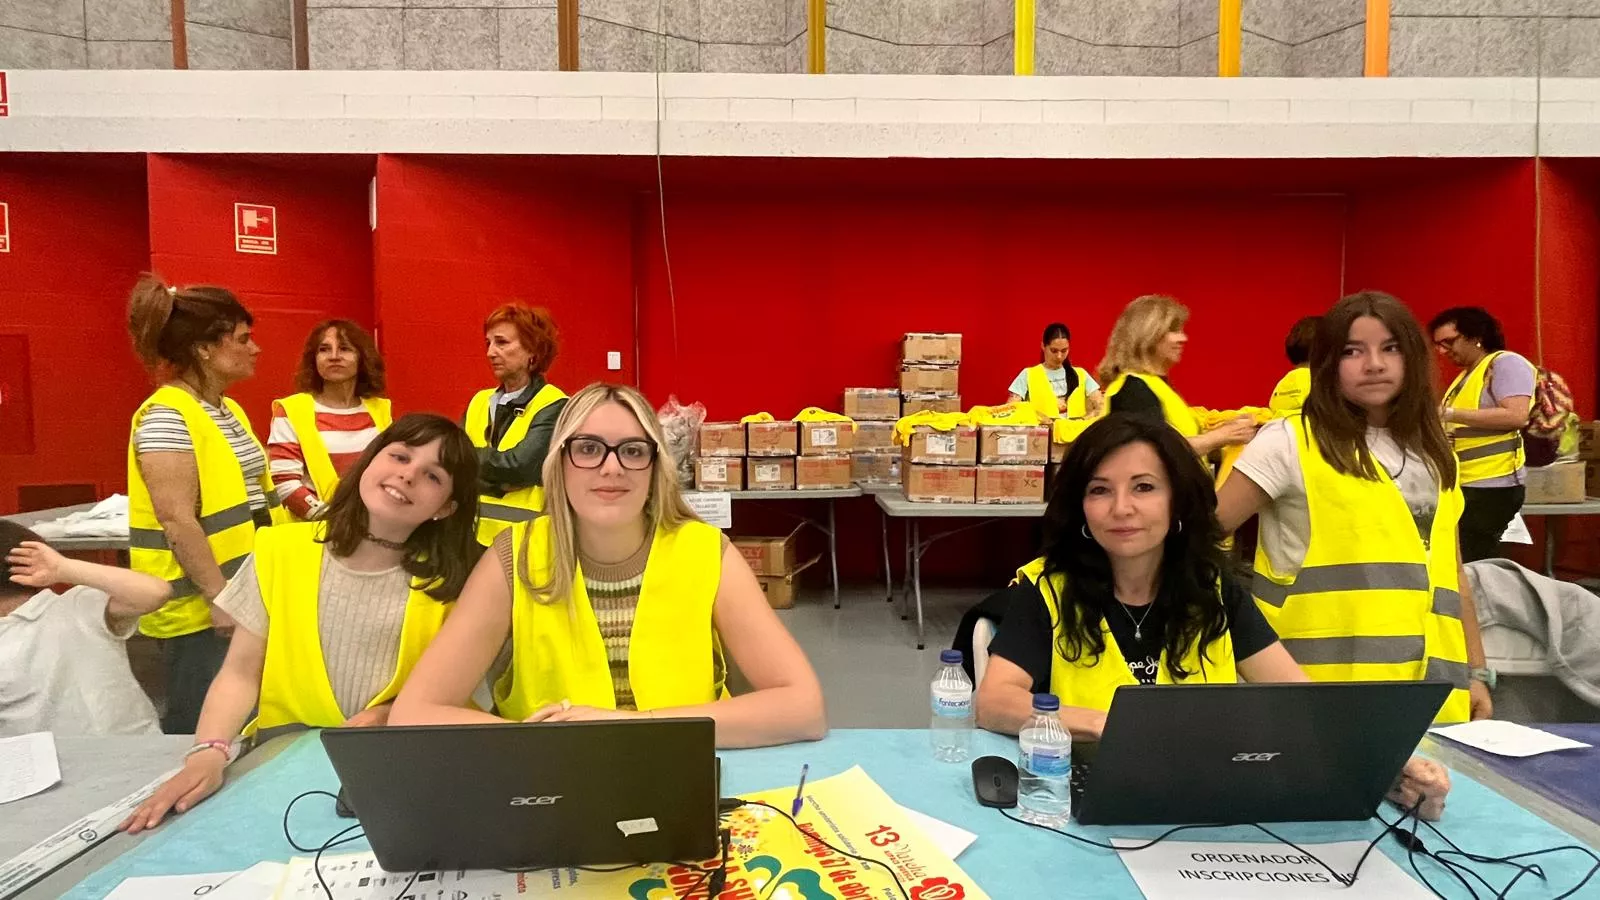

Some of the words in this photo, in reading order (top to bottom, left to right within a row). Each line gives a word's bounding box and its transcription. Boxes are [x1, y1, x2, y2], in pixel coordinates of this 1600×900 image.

[1231, 752, 1281, 761] acer
[509, 795, 564, 806] acer
[865, 824, 900, 847] 13
[819, 856, 851, 869] 27
[1191, 852, 1317, 865] ORDENADOR
[828, 869, 857, 884] de
[1178, 869, 1330, 883] INSCRIPCIONES
